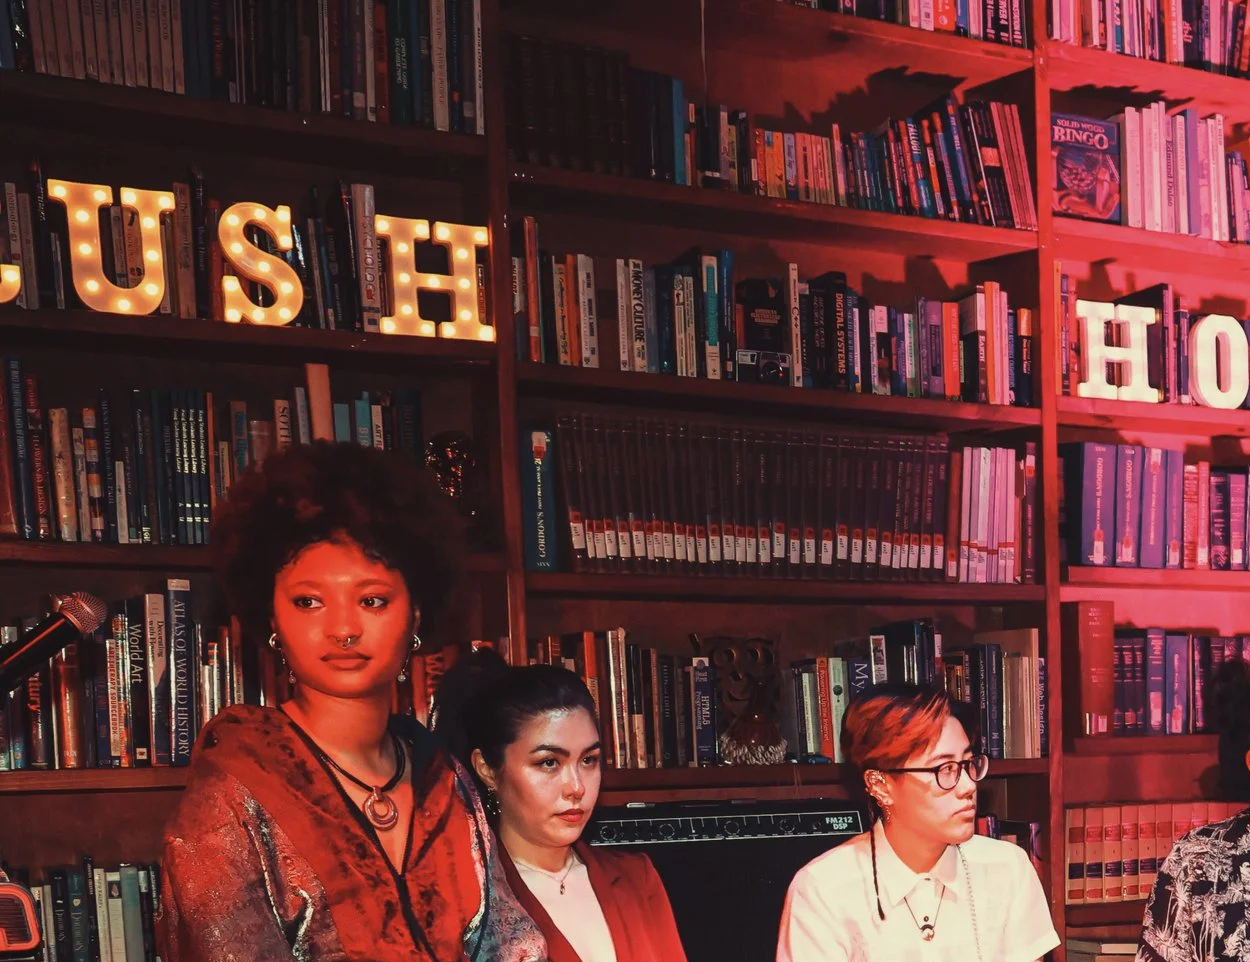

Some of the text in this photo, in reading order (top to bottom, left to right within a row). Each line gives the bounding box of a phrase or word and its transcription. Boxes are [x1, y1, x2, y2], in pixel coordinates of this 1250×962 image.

[907, 123, 922, 156] FALLOUT
[1052, 125, 1109, 150] BINGO
[1056, 118, 1080, 129] SOLID
[1166, 140, 1174, 178] Edmund
[0, 178, 496, 342] USH
[631, 269, 643, 303] MONEY
[632, 303, 646, 343] CULTURE
[835, 293, 847, 374] DIGITAL SYSTEMS
[978, 335, 986, 362] EARTH
[279, 406, 292, 446] SOTH
[358, 427, 369, 448] BIR
[374, 424, 383, 437] ART
[32, 435, 43, 473] FLOWERS
[1095, 457, 1104, 497] GORDON'S
[1125, 460, 1133, 499] GORDON'S
[36, 487, 46, 515] DESIGN
[537, 512, 547, 558] GORDON'S
[149, 620, 157, 636] with
[157, 620, 166, 658] Decorating
[128, 624, 144, 684] World Art
[109, 645, 119, 735] ART THERAPY SOURCEBOOK
[173, 600, 190, 757] ATLAS OF WORLD HISTORY
[817, 670, 827, 697] Powering
[851, 662, 869, 694] My
[694, 691, 702, 730] Programming
[819, 698, 827, 706] Up
[822, 718, 831, 742] Internet
[1039, 704, 1047, 734] Design
[825, 816, 853, 825] FM212
[832, 822, 848, 831] DSP
